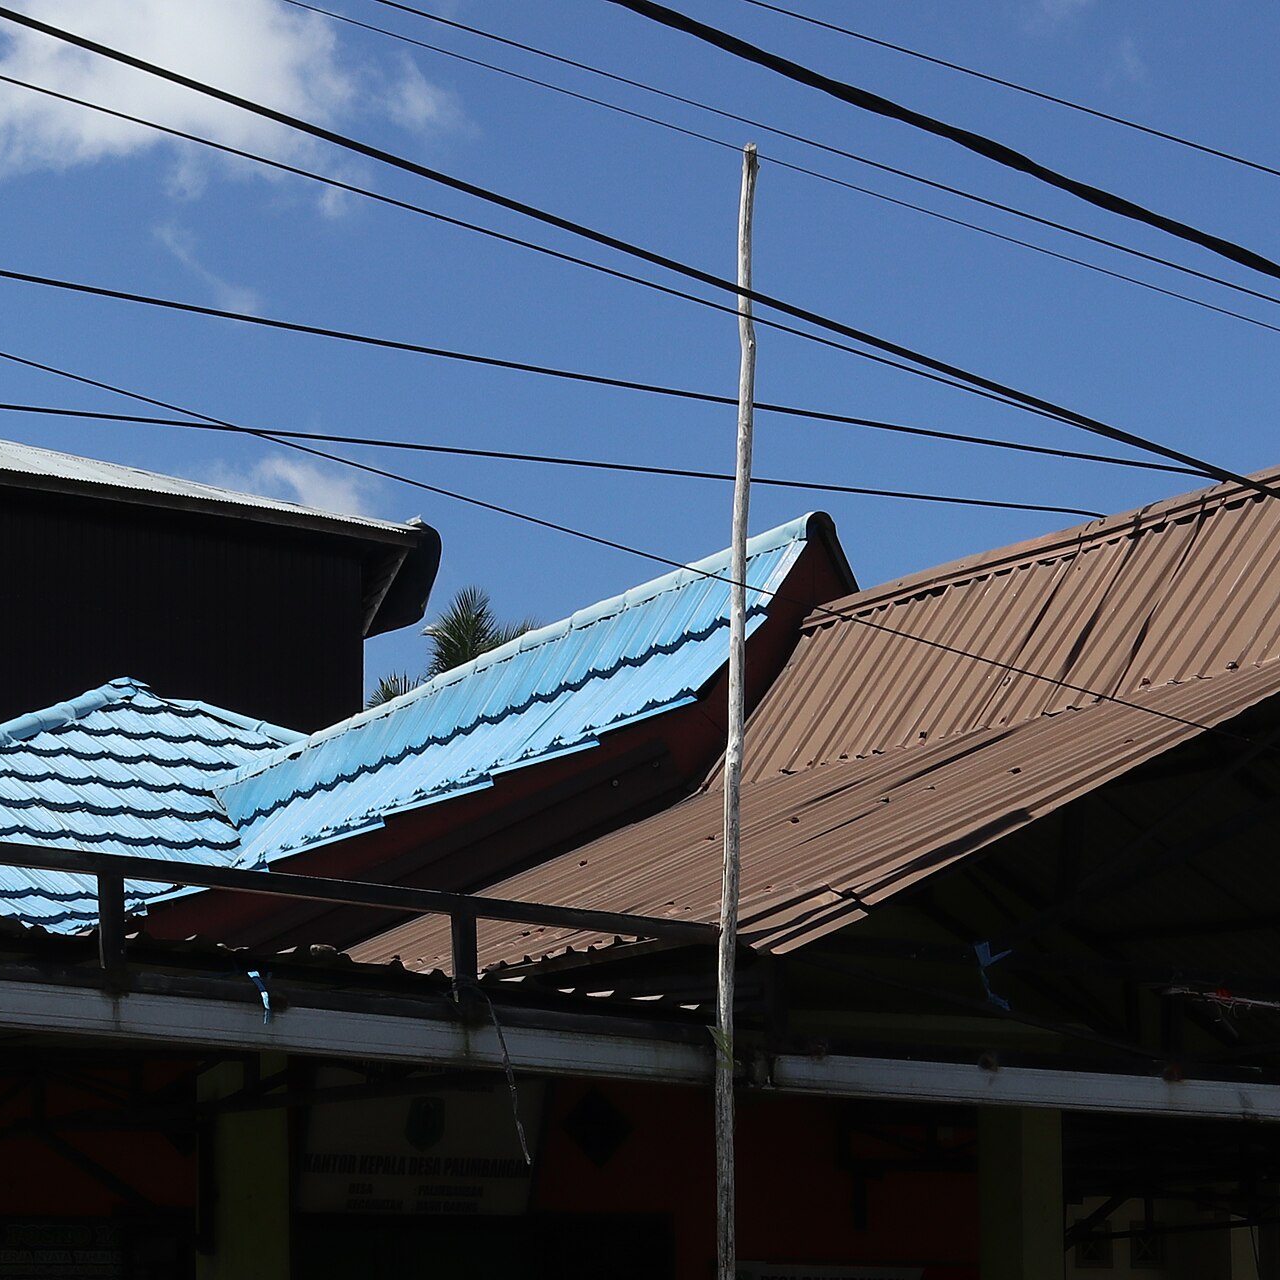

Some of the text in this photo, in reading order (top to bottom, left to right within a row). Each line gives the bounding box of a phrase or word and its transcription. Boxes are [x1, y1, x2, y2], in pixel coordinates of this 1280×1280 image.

[304, 1153, 530, 1179] KANTOR KEPALA DESA PALIMBANGAN
